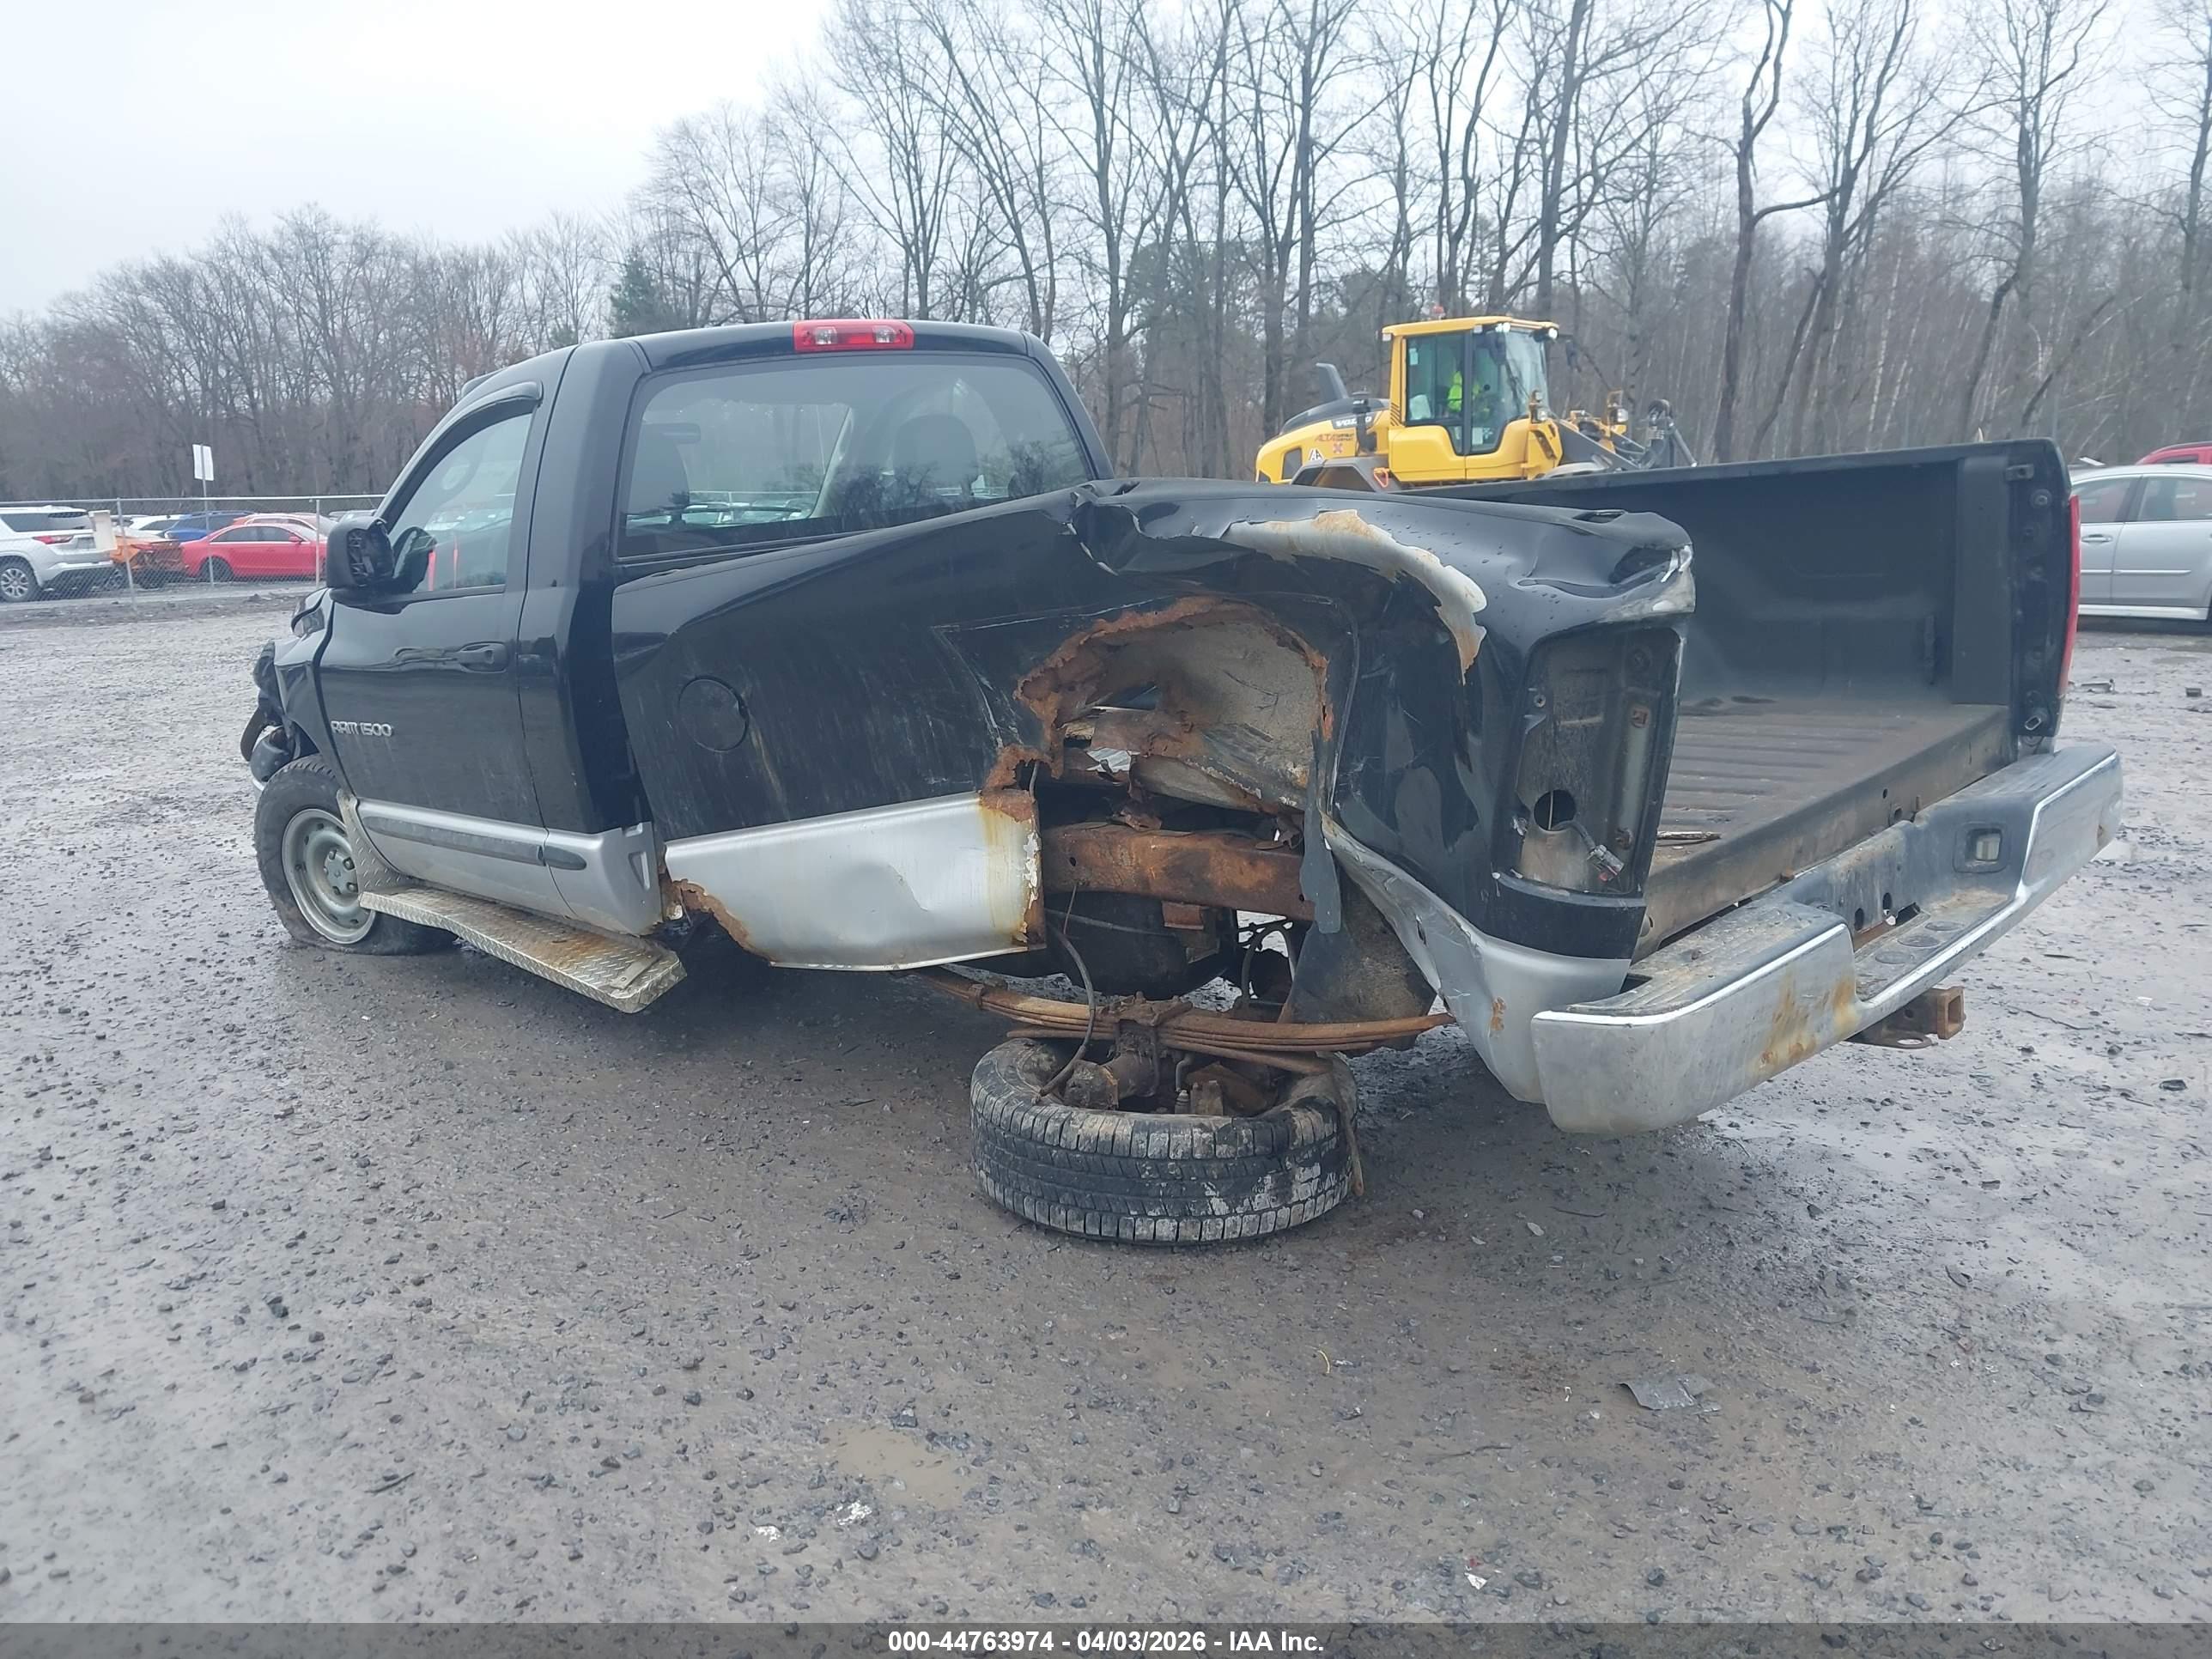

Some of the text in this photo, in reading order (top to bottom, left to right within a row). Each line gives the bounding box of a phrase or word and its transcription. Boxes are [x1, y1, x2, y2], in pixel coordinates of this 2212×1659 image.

[1335, 416, 1372, 427] VOLO
[331, 720, 392, 737] RAM 1500
